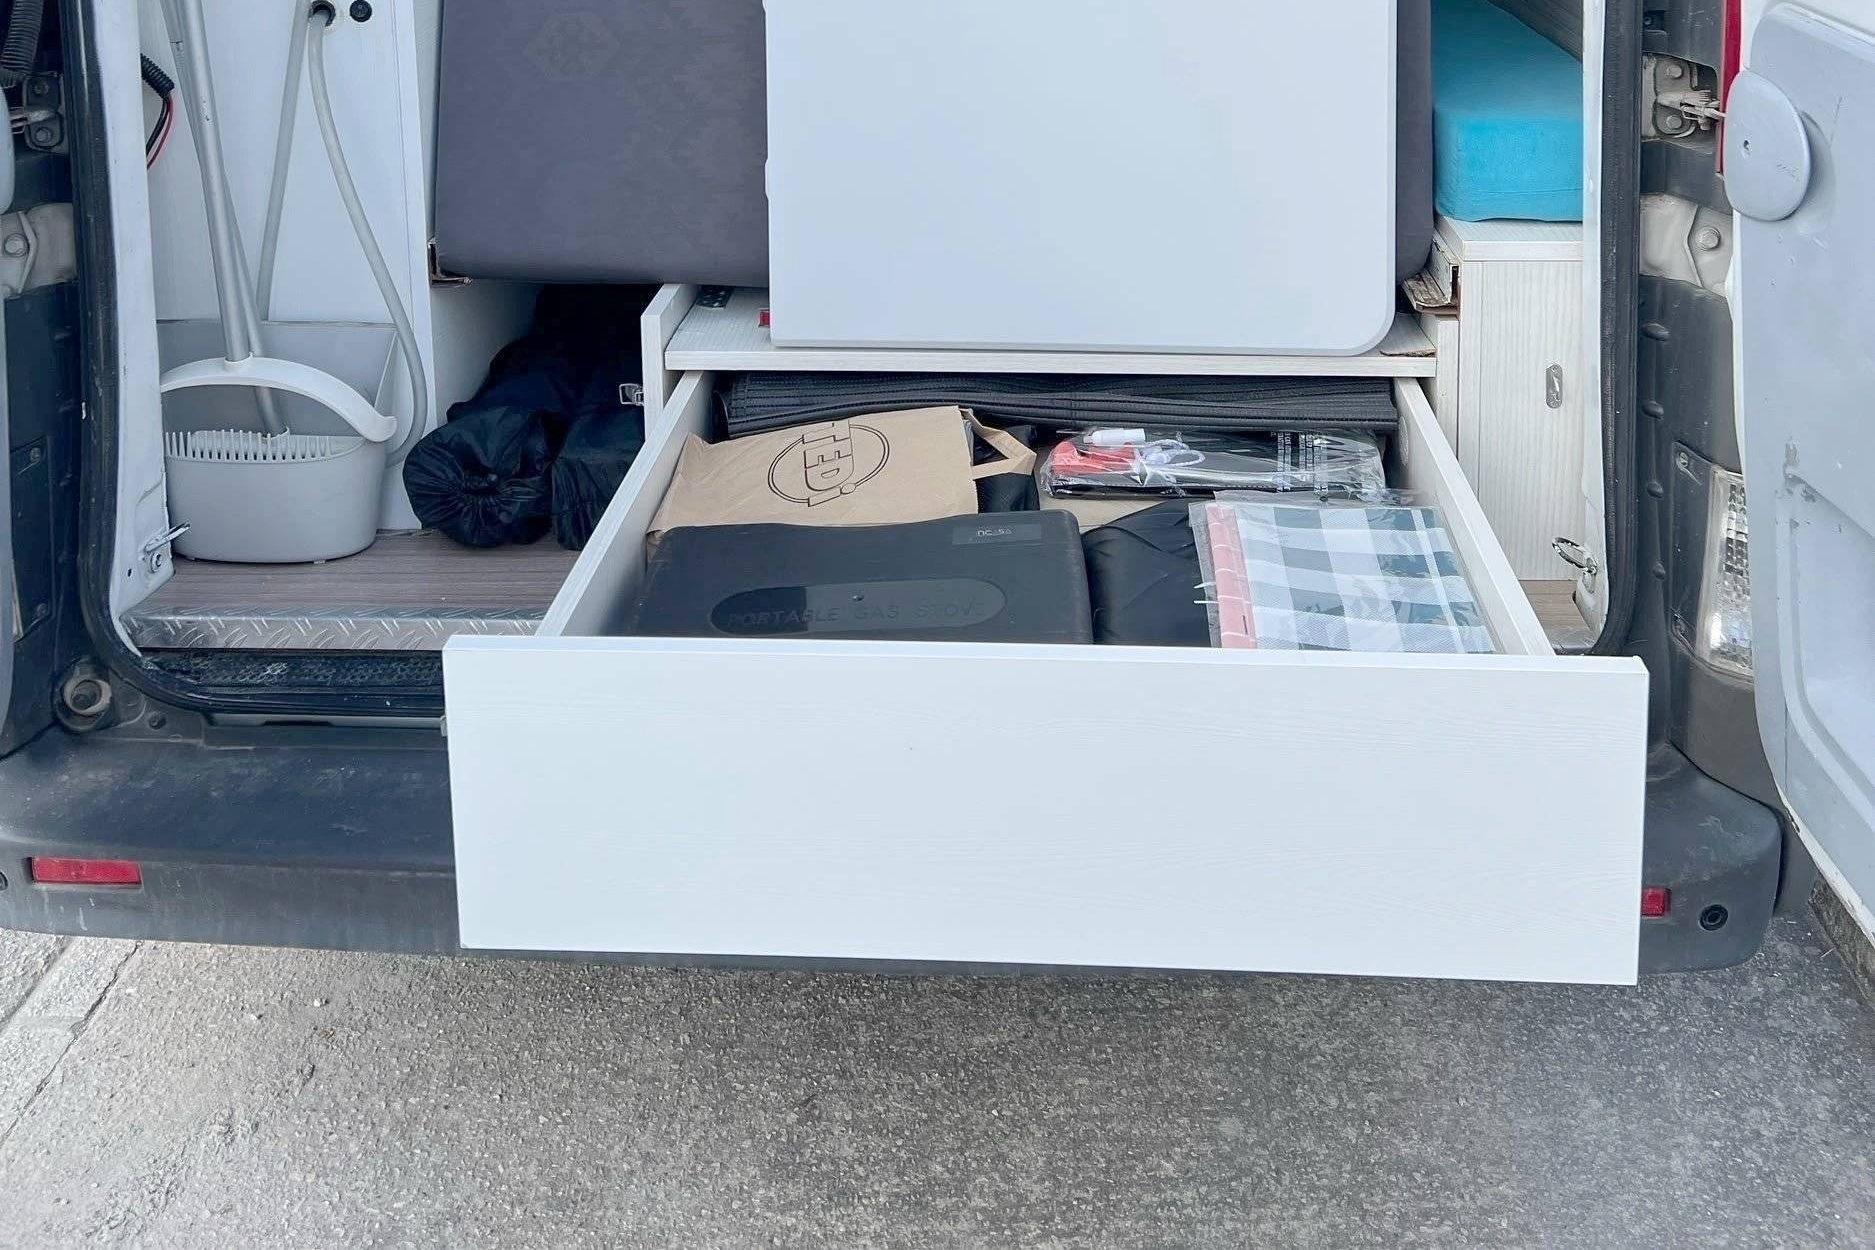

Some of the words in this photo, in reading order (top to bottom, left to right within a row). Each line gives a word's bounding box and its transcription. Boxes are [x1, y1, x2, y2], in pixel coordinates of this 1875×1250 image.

[727, 606, 840, 626] PORTABLE
[854, 604, 899, 620] GAS
[911, 602, 985, 618] STOVE
